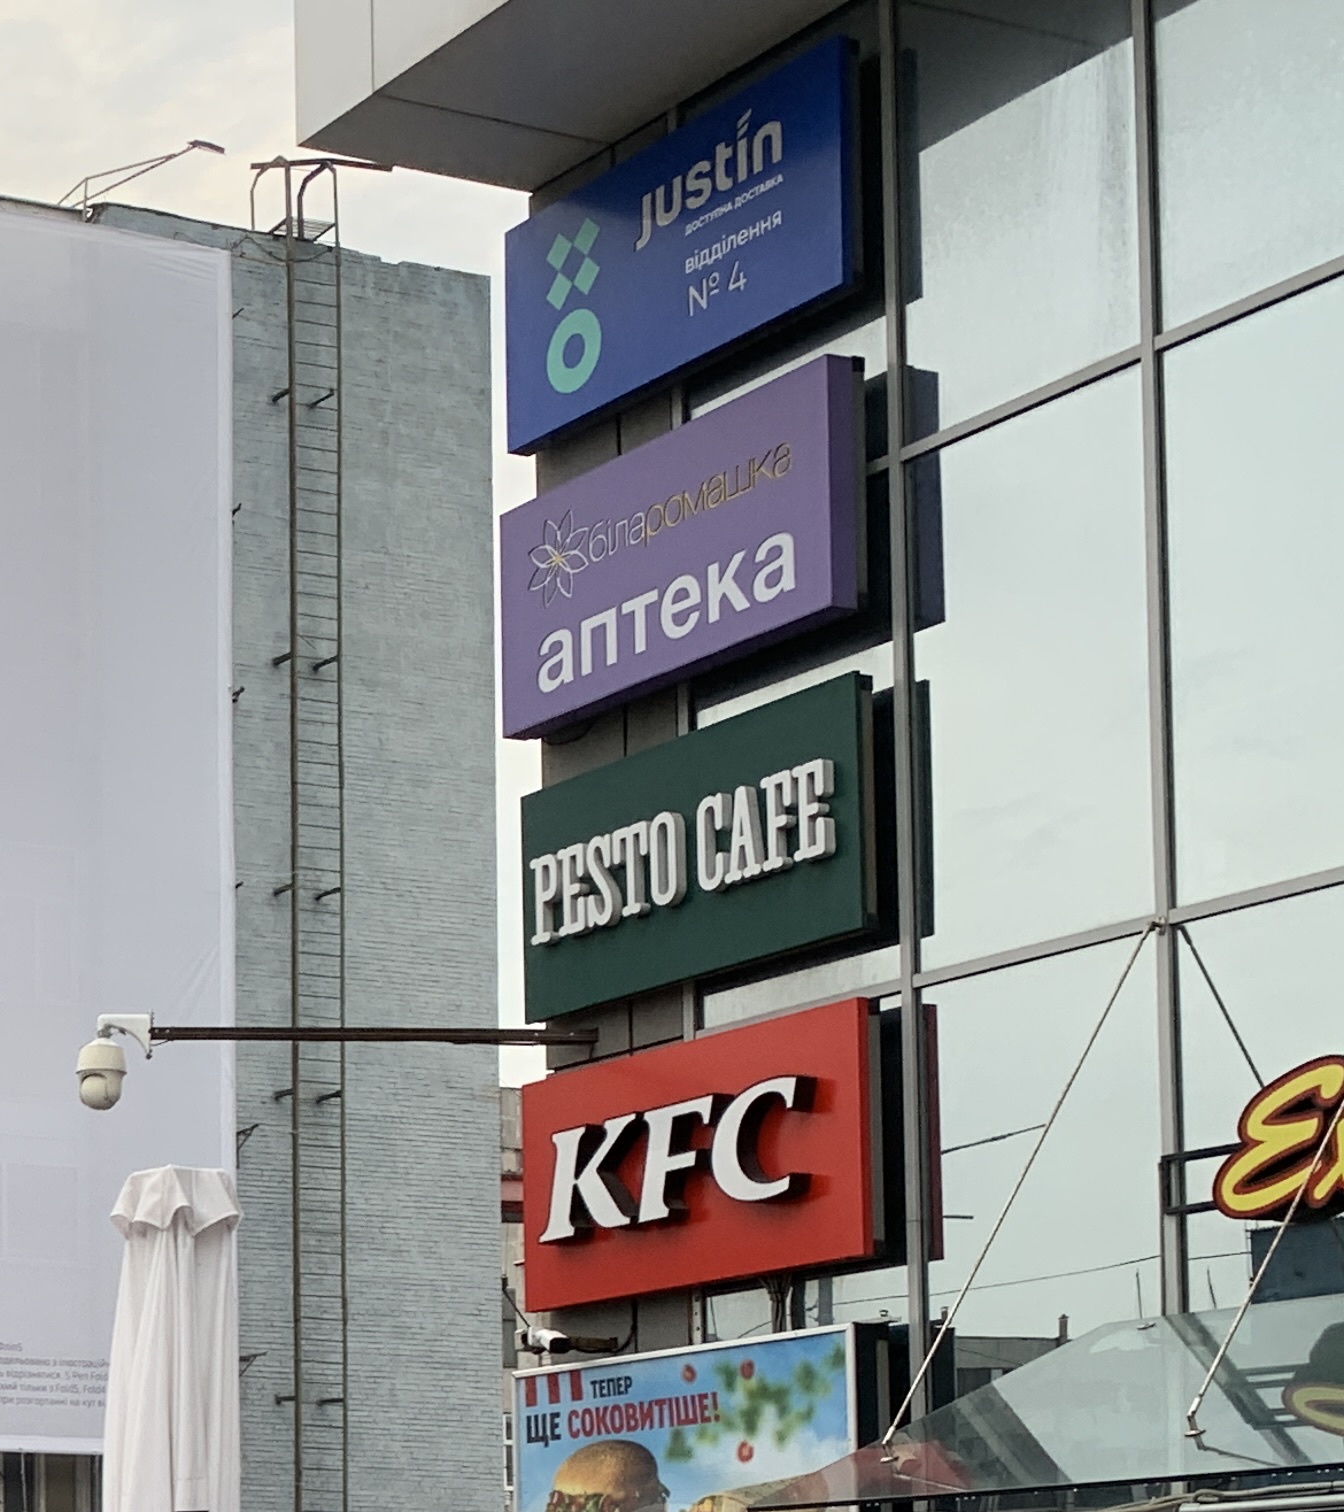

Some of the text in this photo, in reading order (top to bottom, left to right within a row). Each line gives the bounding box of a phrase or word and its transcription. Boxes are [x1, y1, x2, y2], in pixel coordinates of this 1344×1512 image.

[734, 174, 783, 210] ДОСТАВКА
[685, 210, 782, 274] відділення
[727, 260, 747, 292] 4
[537, 532, 796, 693] аптека
[530, 757, 836, 945] PESTO CAFE
[539, 1075, 806, 1244] KFC
[590, 1376, 633, 1399] ТЕПЕР
[526, 1391, 721, 1447] ЩЕ СОКОВИТІШЕ!
